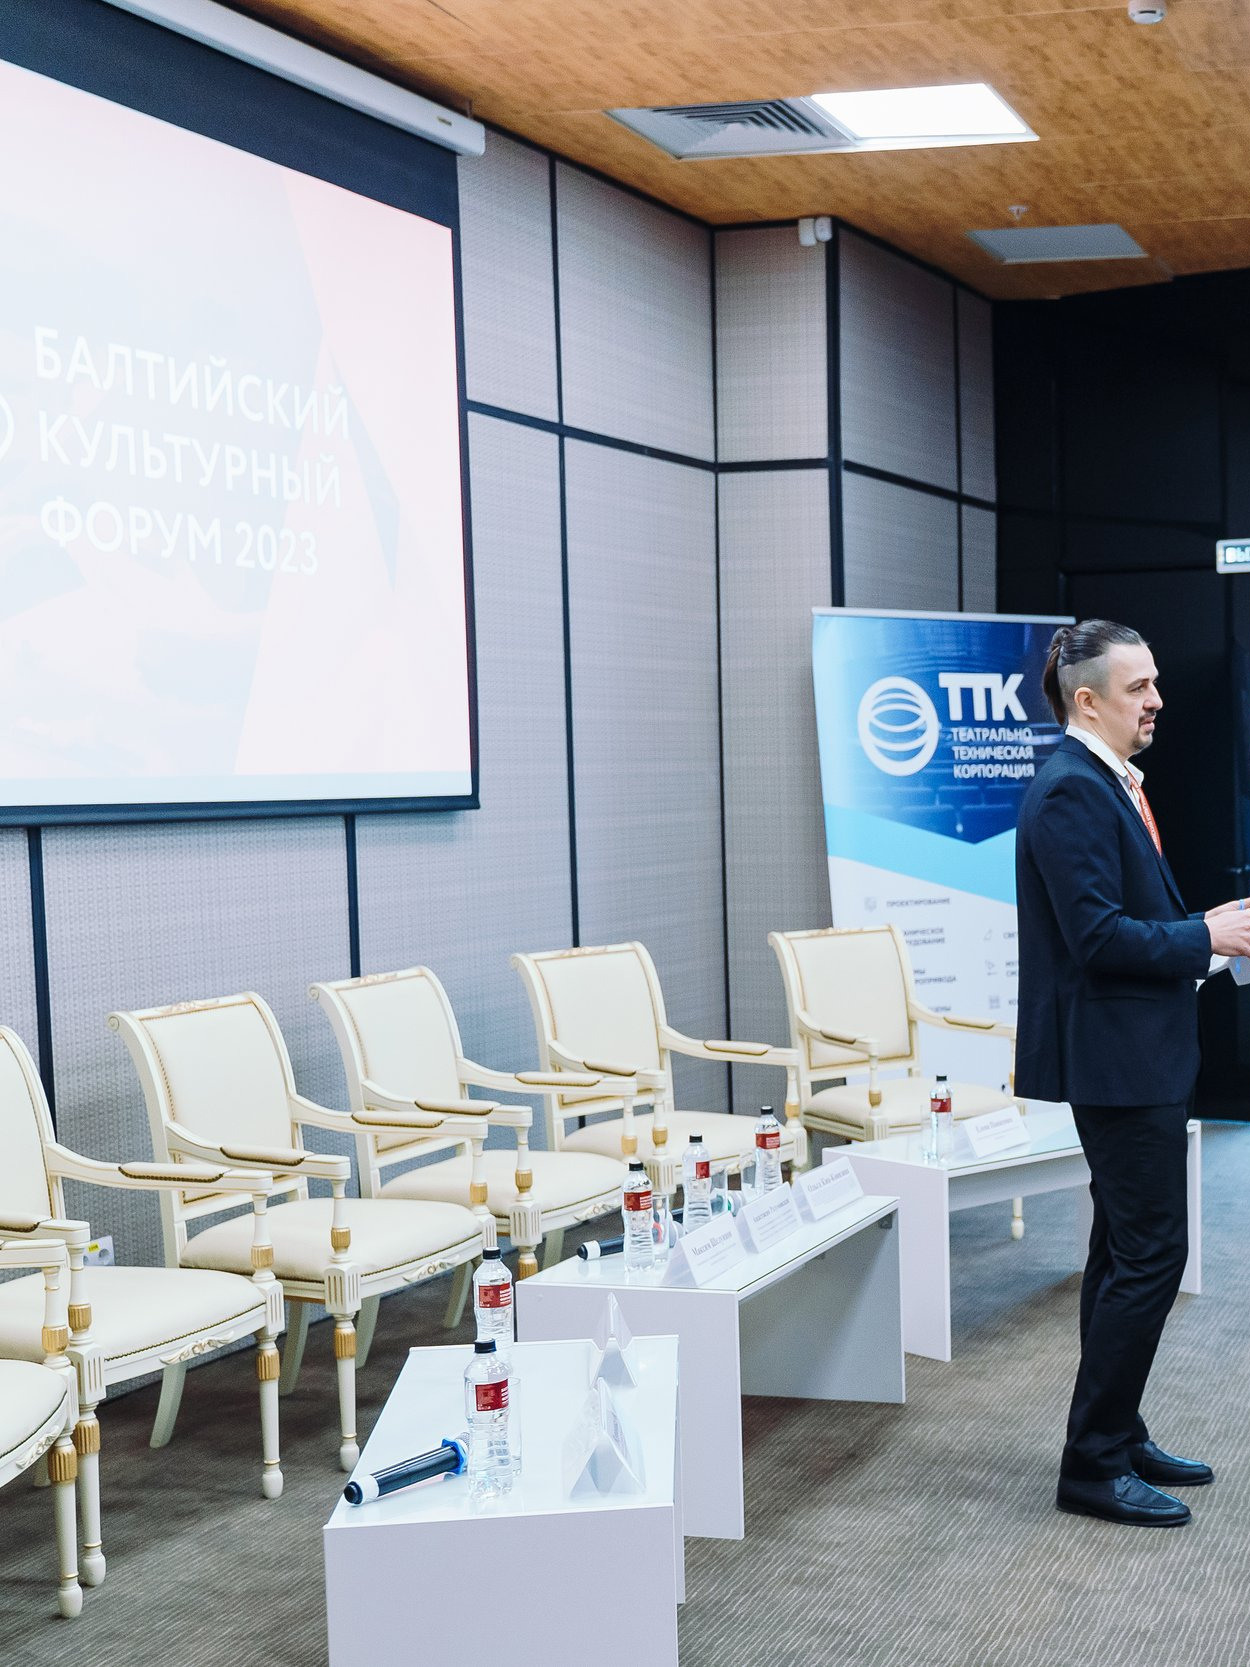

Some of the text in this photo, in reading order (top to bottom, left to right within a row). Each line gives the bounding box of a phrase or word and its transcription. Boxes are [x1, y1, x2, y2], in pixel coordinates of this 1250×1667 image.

[34, 326, 350, 440] БАЛТИЙСКИЙ
[38, 410, 343, 509] КУЛЬТУРНЫЙ
[40, 495, 319, 576] ФОРУМ 2023
[951, 726, 1034, 743] ТЕАТРАЛЬНО
[952, 745, 1035, 761] ТЕХНИЧЕСКАЯ
[953, 763, 1036, 780] КОРПОРАЦИЯ
